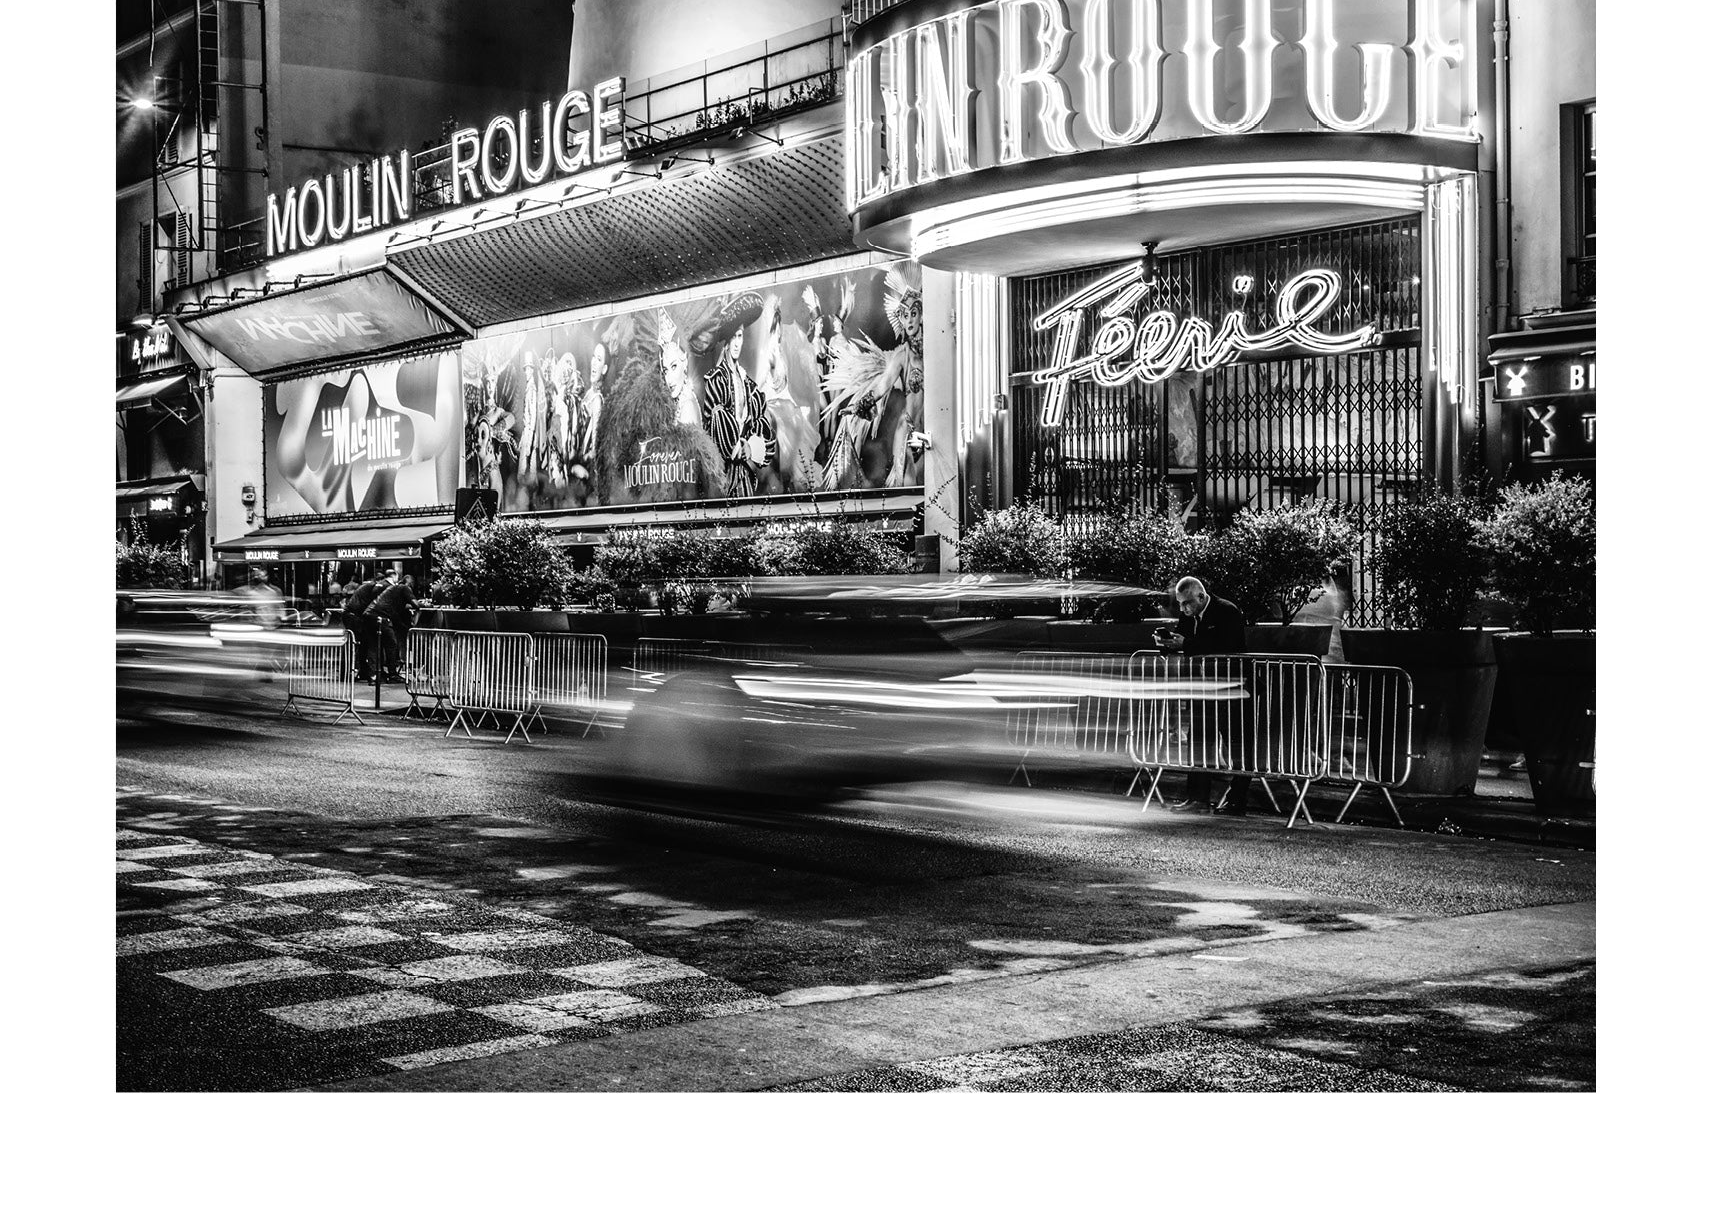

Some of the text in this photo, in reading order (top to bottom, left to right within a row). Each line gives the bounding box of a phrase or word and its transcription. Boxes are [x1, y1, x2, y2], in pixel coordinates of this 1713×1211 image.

[845, 10, 970, 212] LIN
[266, 76, 626, 257] MOULIN ROUGE
[321, 409, 334, 432] LA
[633, 436, 683, 465] Forever
[623, 458, 697, 490] MOULIN ROUGE
[337, 548, 377, 559] MOULIN ROUGE
